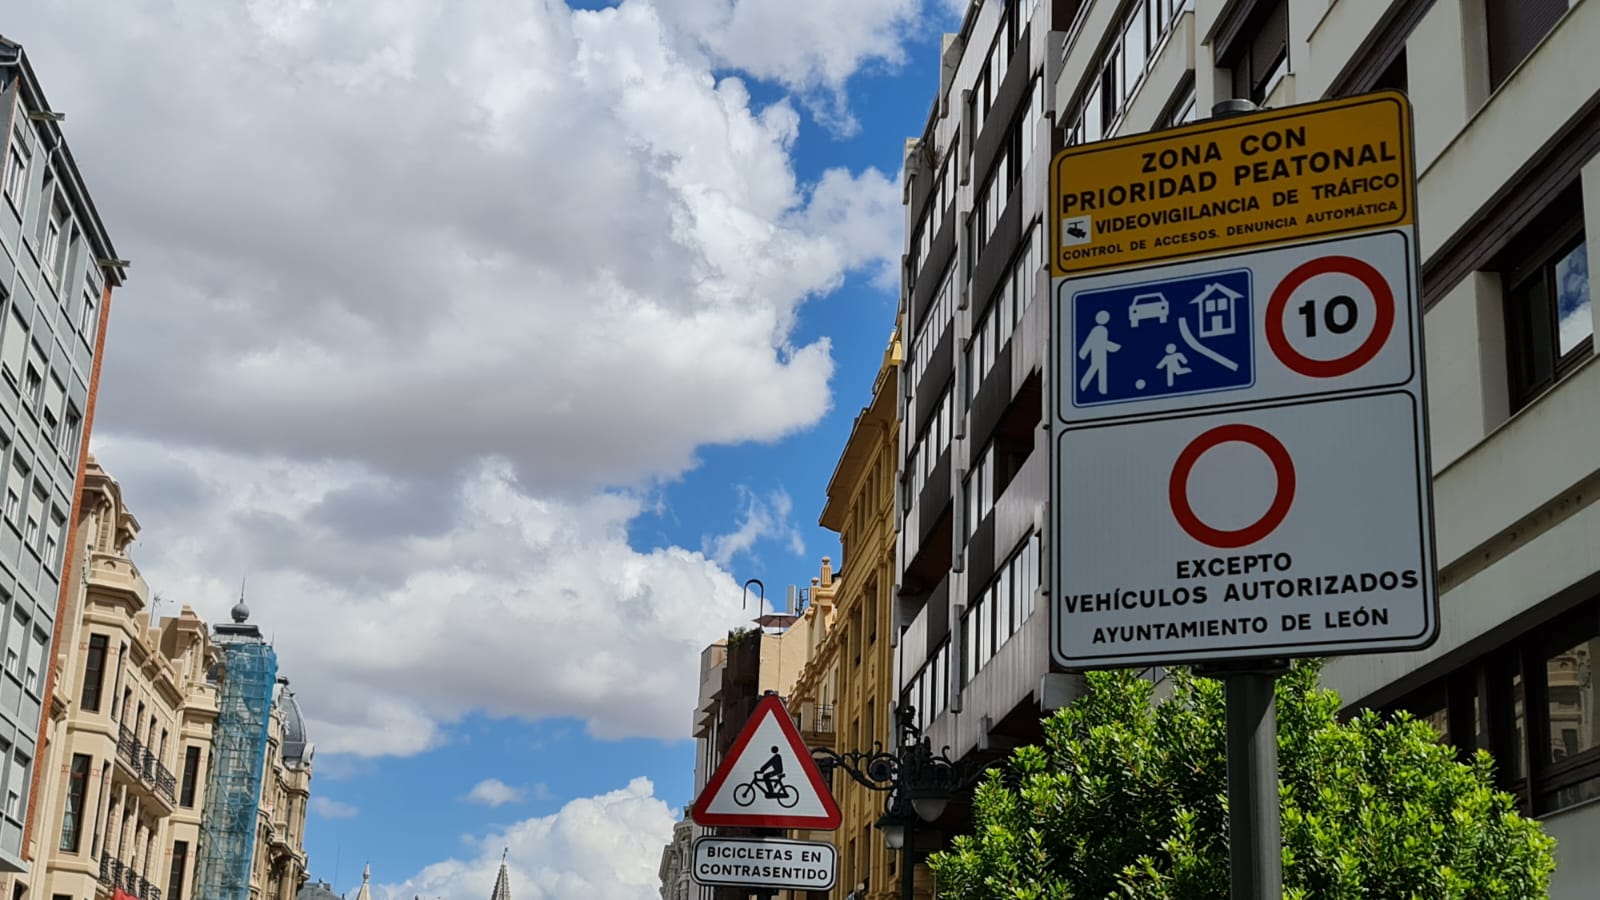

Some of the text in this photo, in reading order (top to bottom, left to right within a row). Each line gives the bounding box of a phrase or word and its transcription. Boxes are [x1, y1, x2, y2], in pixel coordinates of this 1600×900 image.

[1141, 126, 1306, 173] ZONA CON
[1063, 141, 1396, 214] PRIORIDAD PEATONAL
[1096, 173, 1400, 235] VIDEOVIGILANCIA DE TRÁFICO
[1063, 242, 1124, 261] CONTROL
[1130, 239, 1147, 250] DE
[1227, 216, 1297, 237] DENUNCIA
[1306, 200, 1398, 224] AUTOMÁTICA
[1298, 295, 1358, 338] 10
[1176, 552, 1292, 579] EXCEPTO
[1065, 569, 1418, 613] VEHÍCULOS AUTORIZADOS
[1092, 605, 1389, 644] AYUNTAMIENTO DE LEÓN
[700, 863, 828, 880] CONTRASENTIDO
[707, 846, 821, 863] BICICLETAS EN
